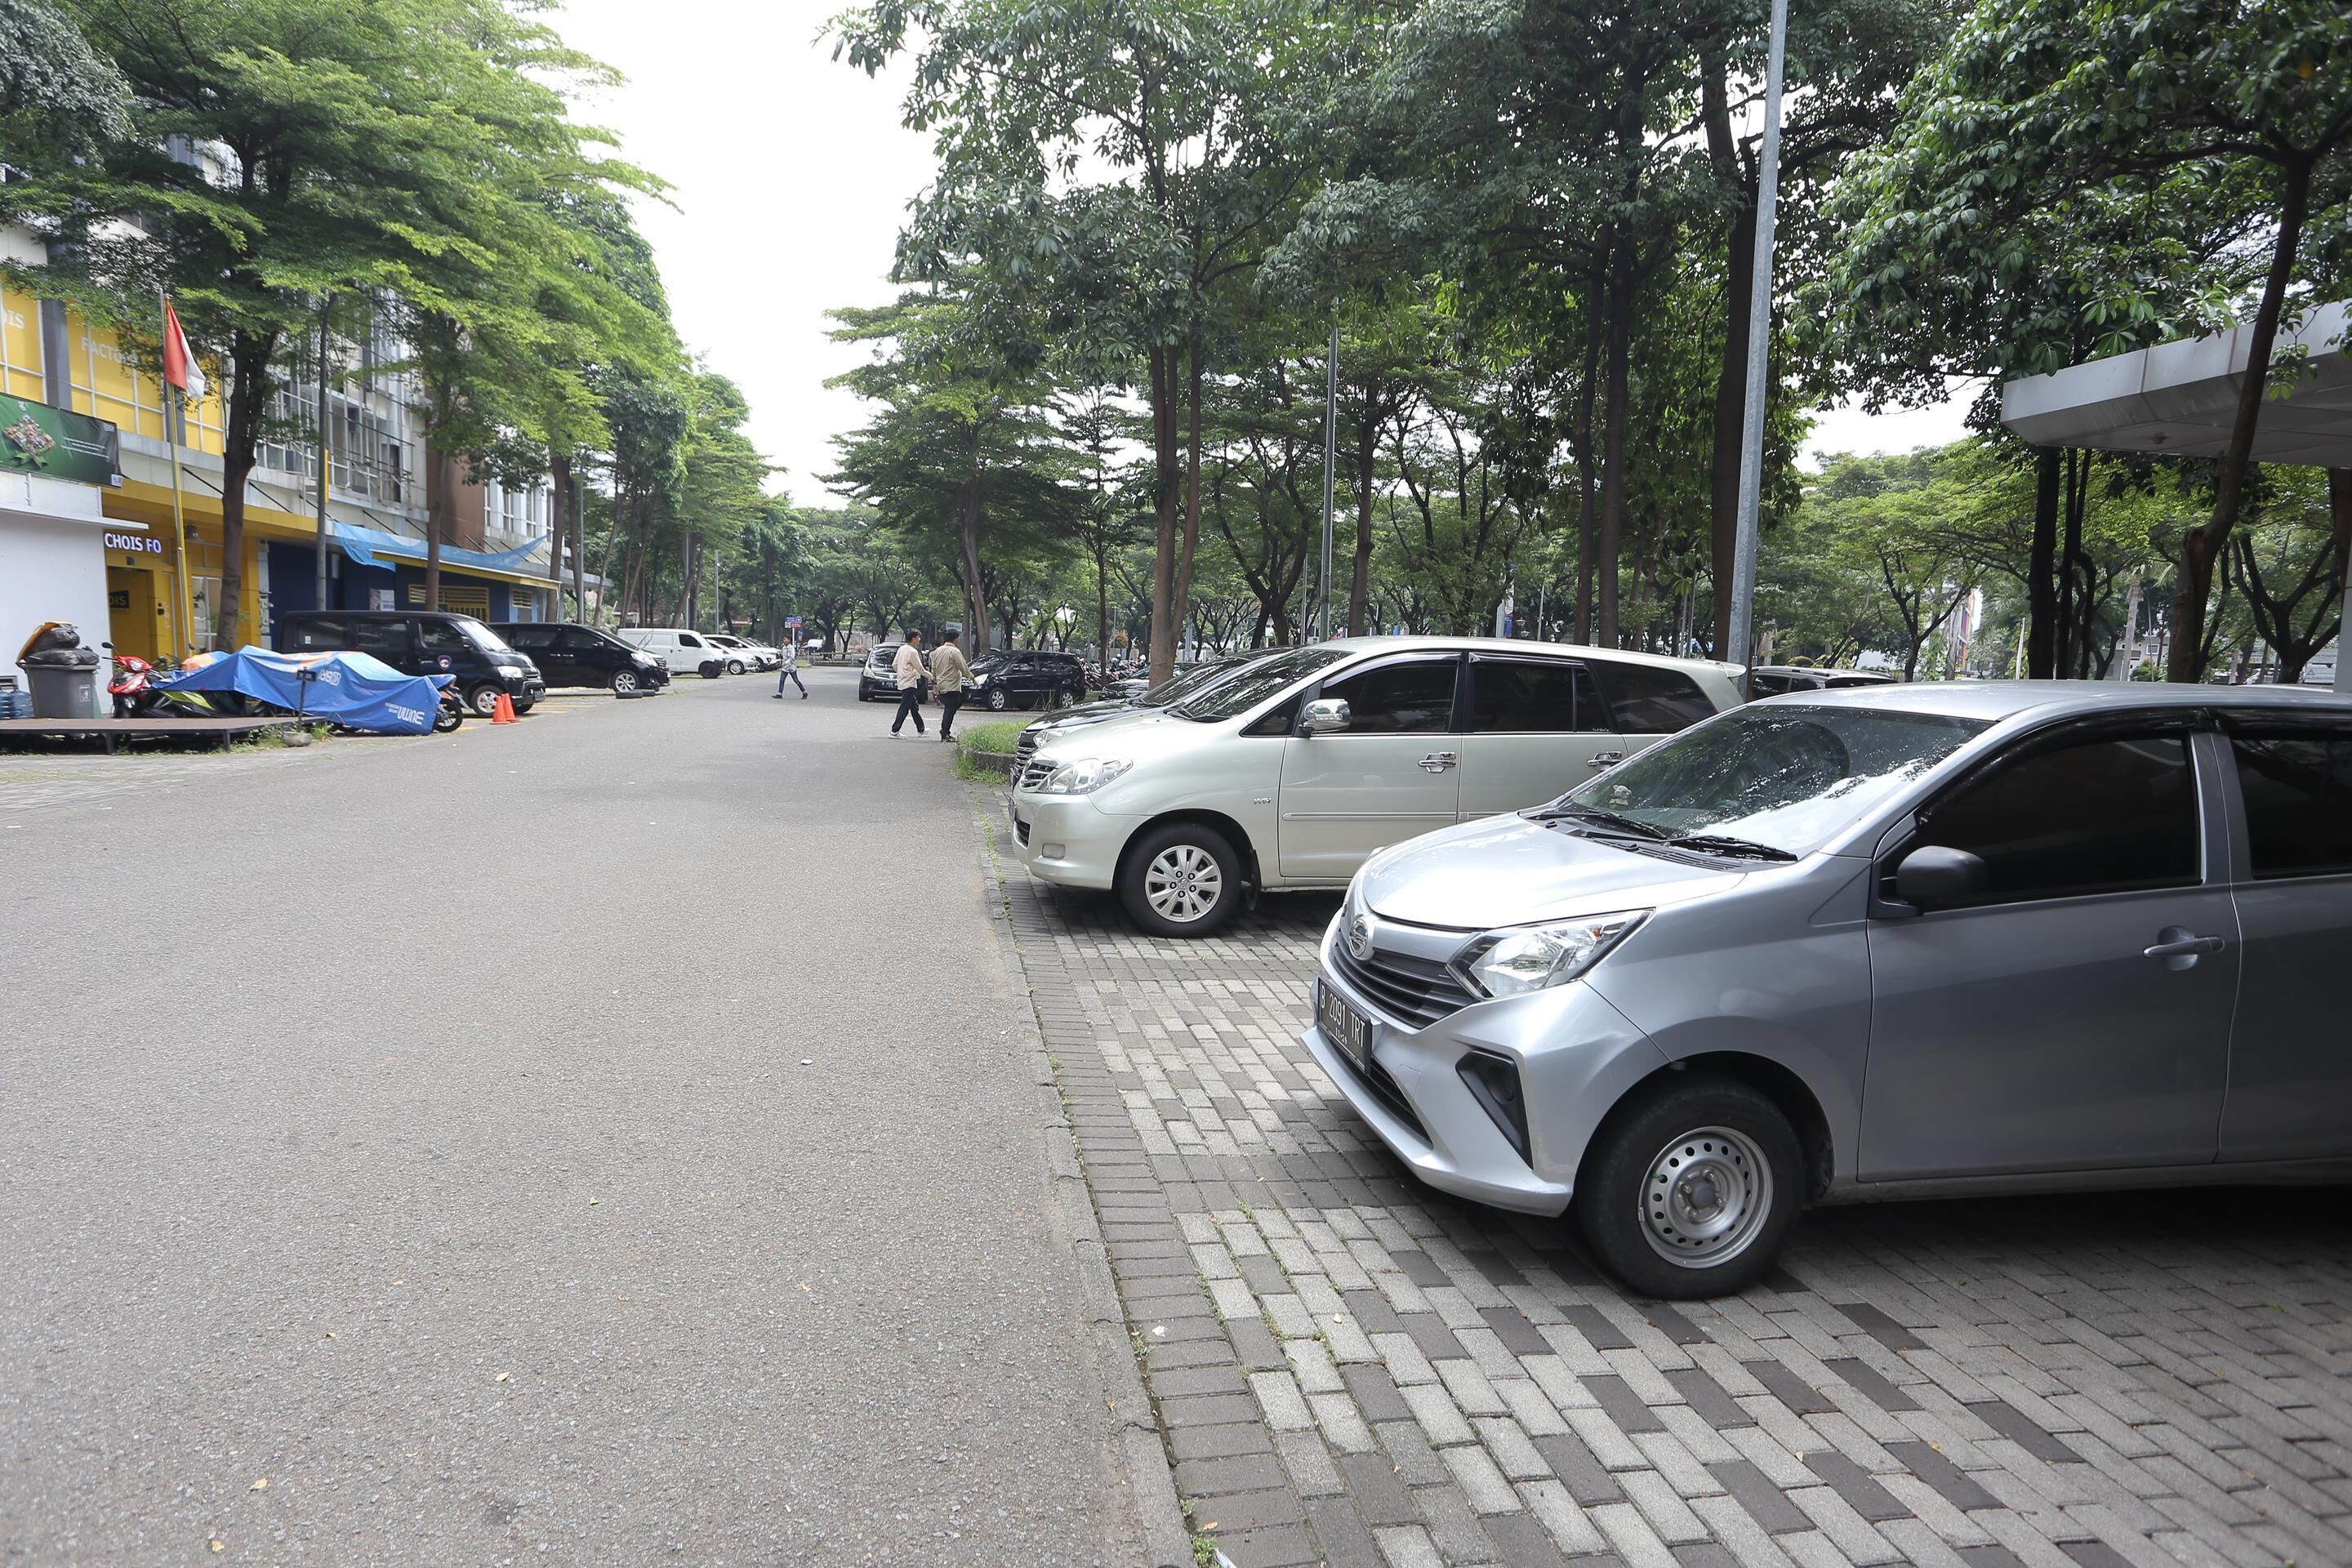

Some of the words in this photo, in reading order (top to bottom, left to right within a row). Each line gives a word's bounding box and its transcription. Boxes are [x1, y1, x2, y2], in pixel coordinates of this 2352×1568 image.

[105, 532, 144, 551] CHOIS
[146, 538, 162, 554] FO
[1321, 984, 1325, 1009] B
[1329, 993, 1346, 1030] 2091
[1351, 1012, 1365, 1049] TRT
